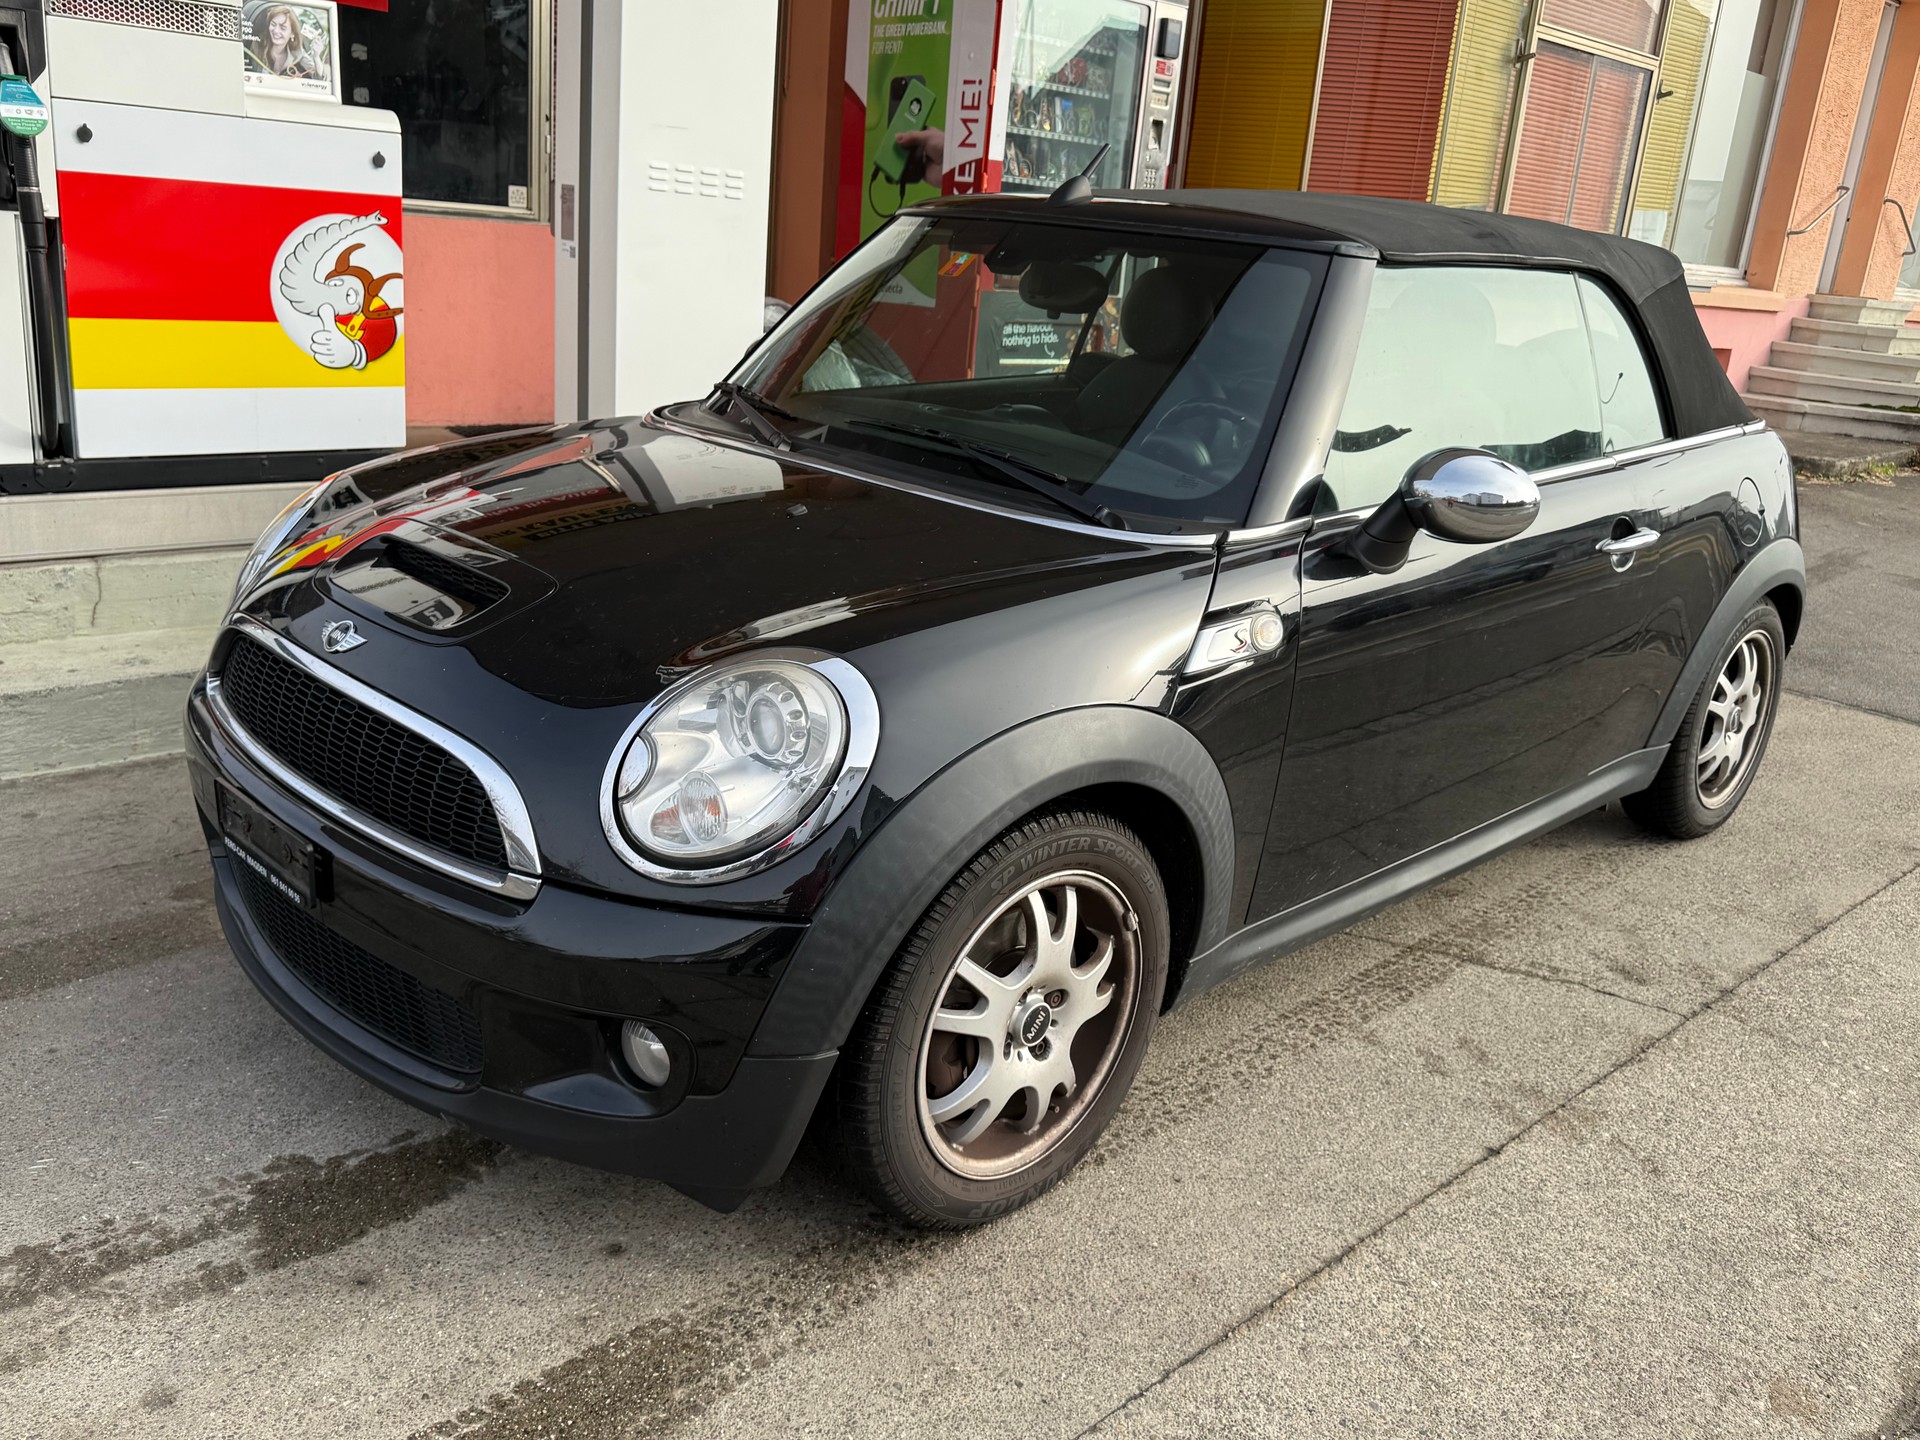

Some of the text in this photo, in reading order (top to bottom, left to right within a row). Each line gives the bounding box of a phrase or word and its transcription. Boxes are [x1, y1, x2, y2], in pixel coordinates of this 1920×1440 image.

[873, 21, 947, 37] THE GREEN POWERBANK
[872, 41, 904, 54] FOR RENT!
[958, 79, 983, 149] ME!
[1002, 332, 1060, 348] nothing to hide.
[990, 866, 1016, 895] SP
[1020, 837, 1091, 873] WINTER
[1094, 838, 1142, 870] SPORT
[1026, 1010, 1046, 1040] MINI
